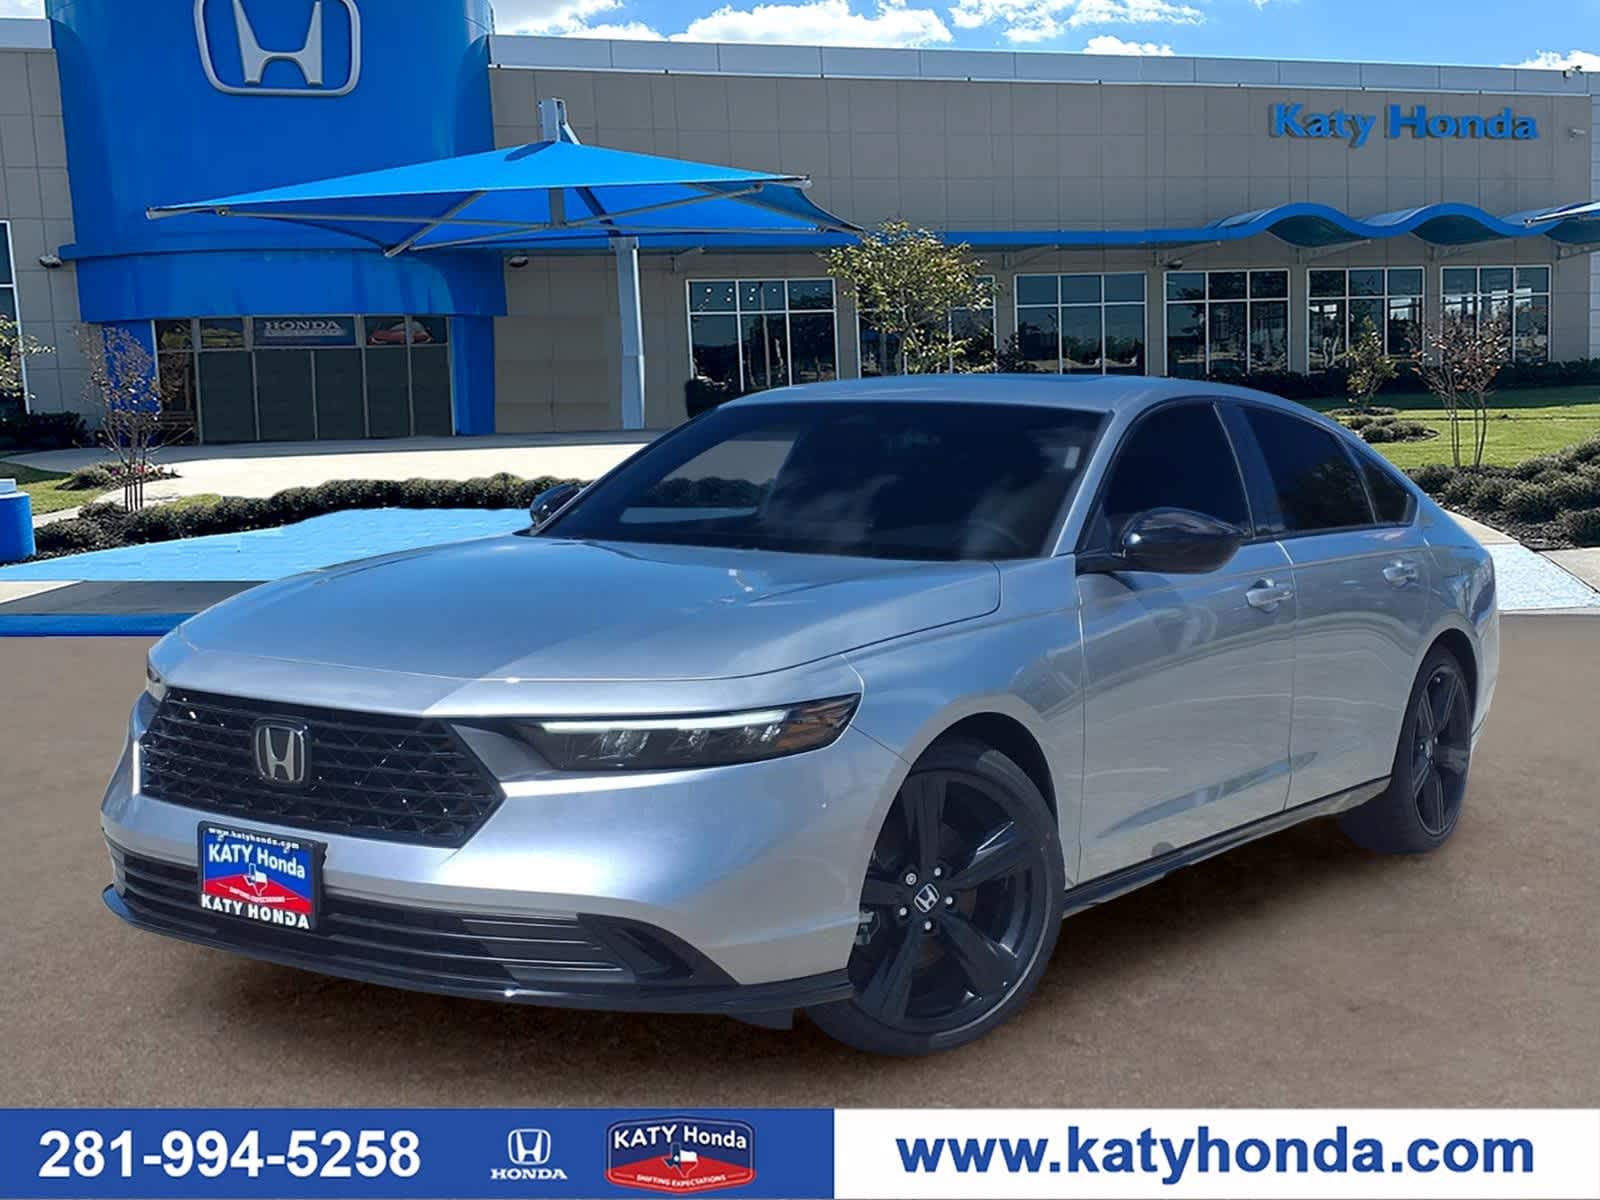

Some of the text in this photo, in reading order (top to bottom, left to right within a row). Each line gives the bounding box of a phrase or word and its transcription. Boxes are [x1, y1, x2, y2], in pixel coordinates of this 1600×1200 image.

[1270, 102, 1539, 148] Katy Honda
[264, 320, 342, 330] HONDA
[208, 843, 306, 879] KATY Honda
[201, 894, 243, 916] KATY
[247, 903, 310, 929] HONDA
